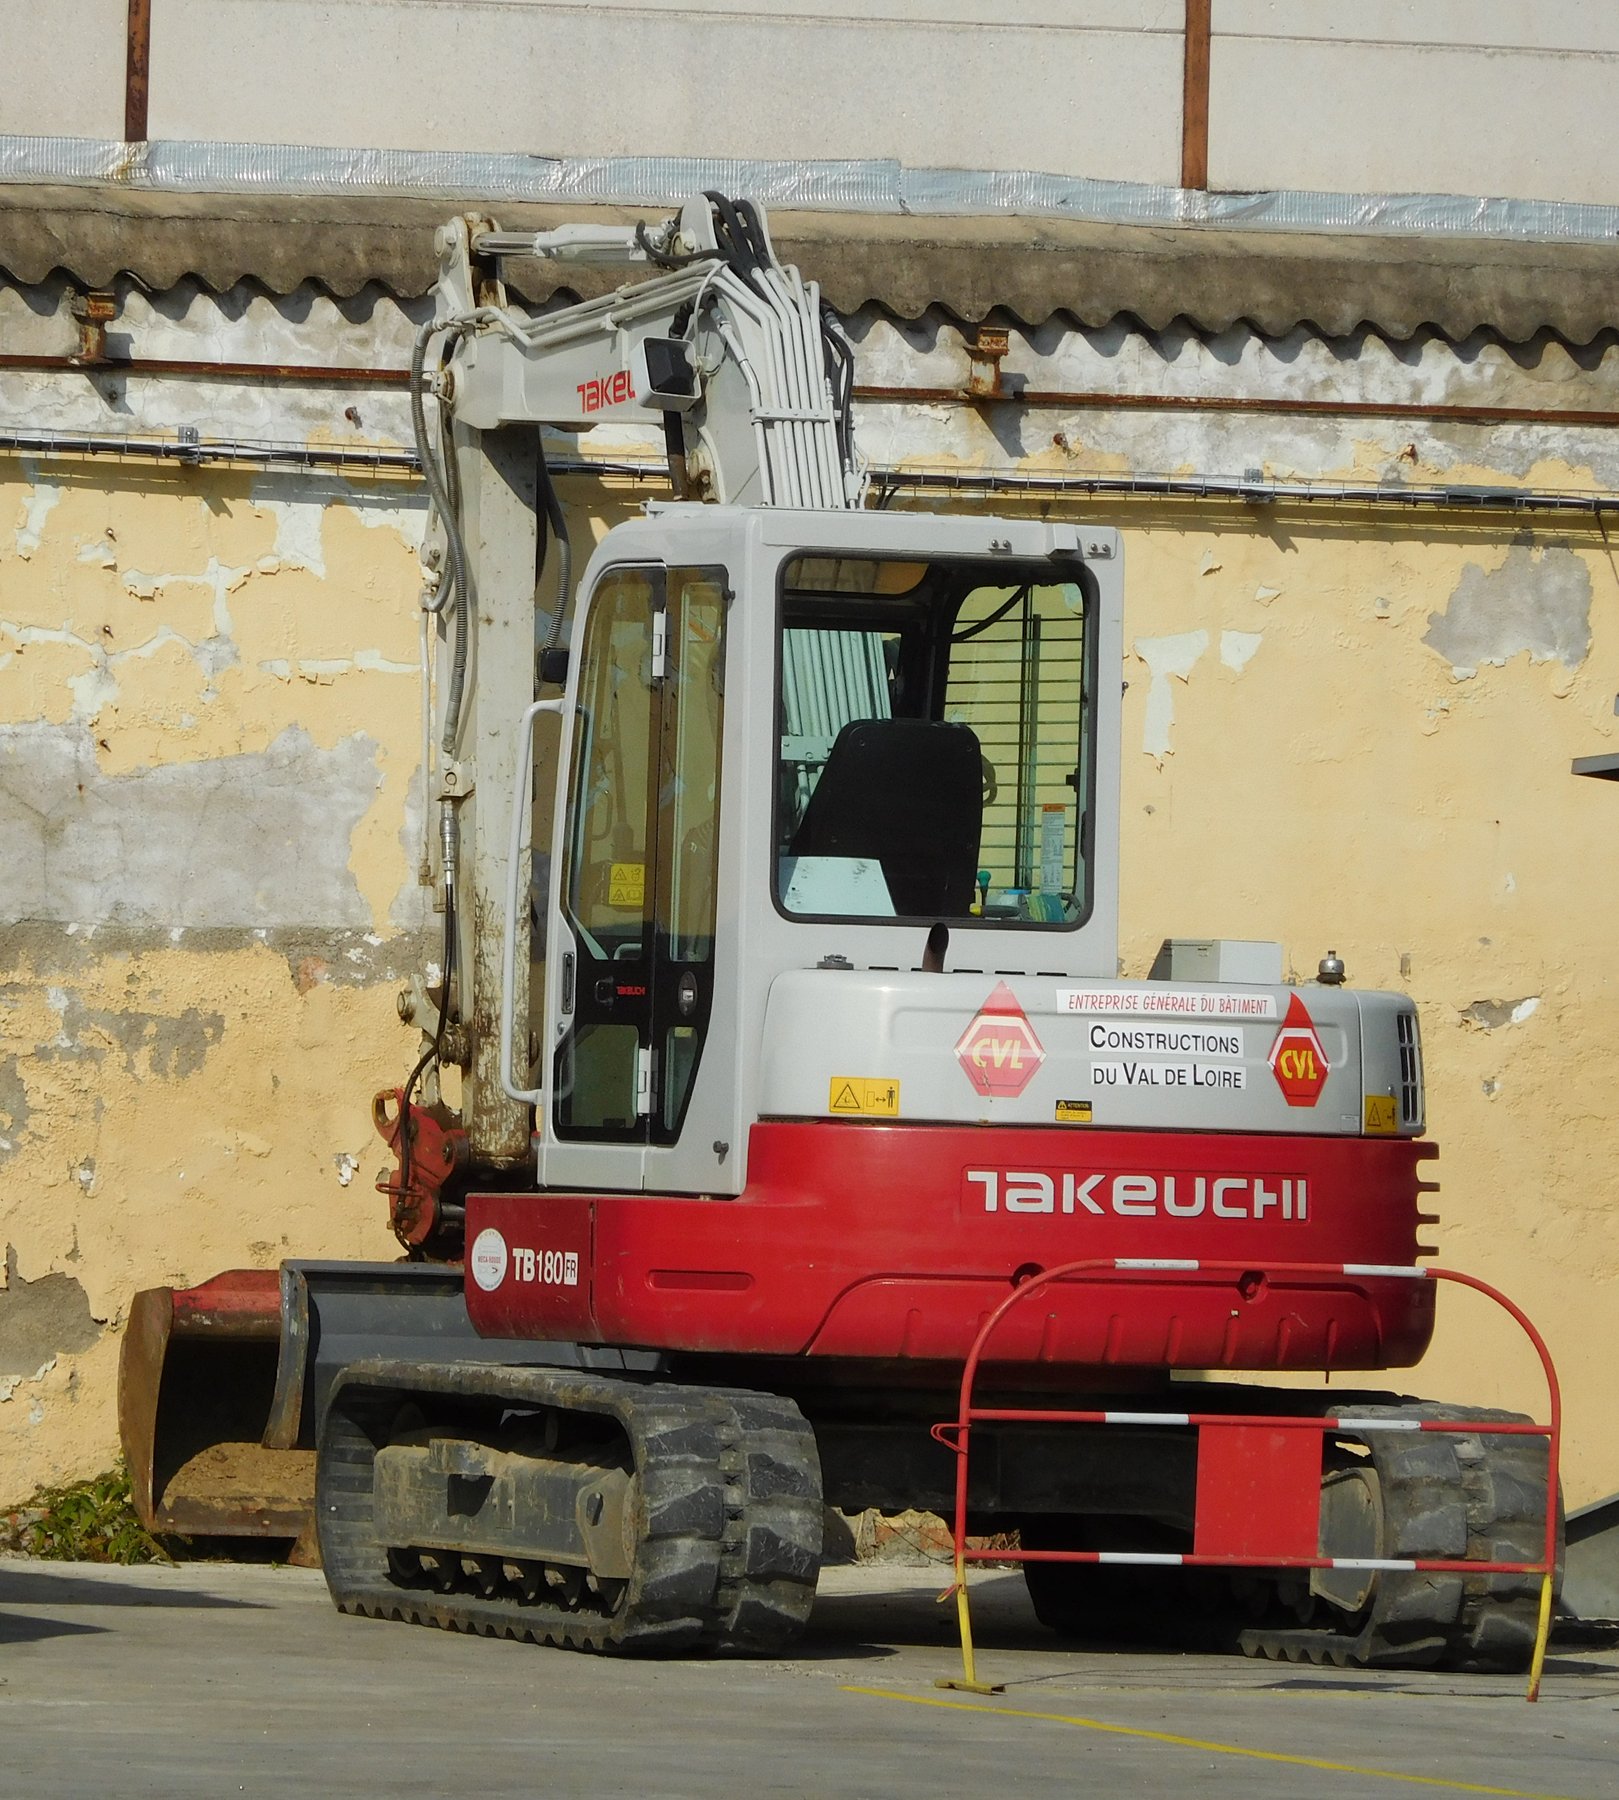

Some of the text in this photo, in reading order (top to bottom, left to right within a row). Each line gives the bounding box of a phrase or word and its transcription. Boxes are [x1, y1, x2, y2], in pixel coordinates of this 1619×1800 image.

[577, 369, 636, 414] TAKEU
[1068, 993, 1268, 1014] ENTREPRISE GÉNÉRALE DU BÂTIMENT
[972, 1037, 1024, 1069] CVL
[1090, 1025, 1240, 1054] CONSTRUCTIONS
[1093, 1063, 1242, 1089] DU VAL DE LOIRE
[1280, 1049, 1318, 1080] CVL
[967, 1171, 1307, 1220] TAKEUCHI
